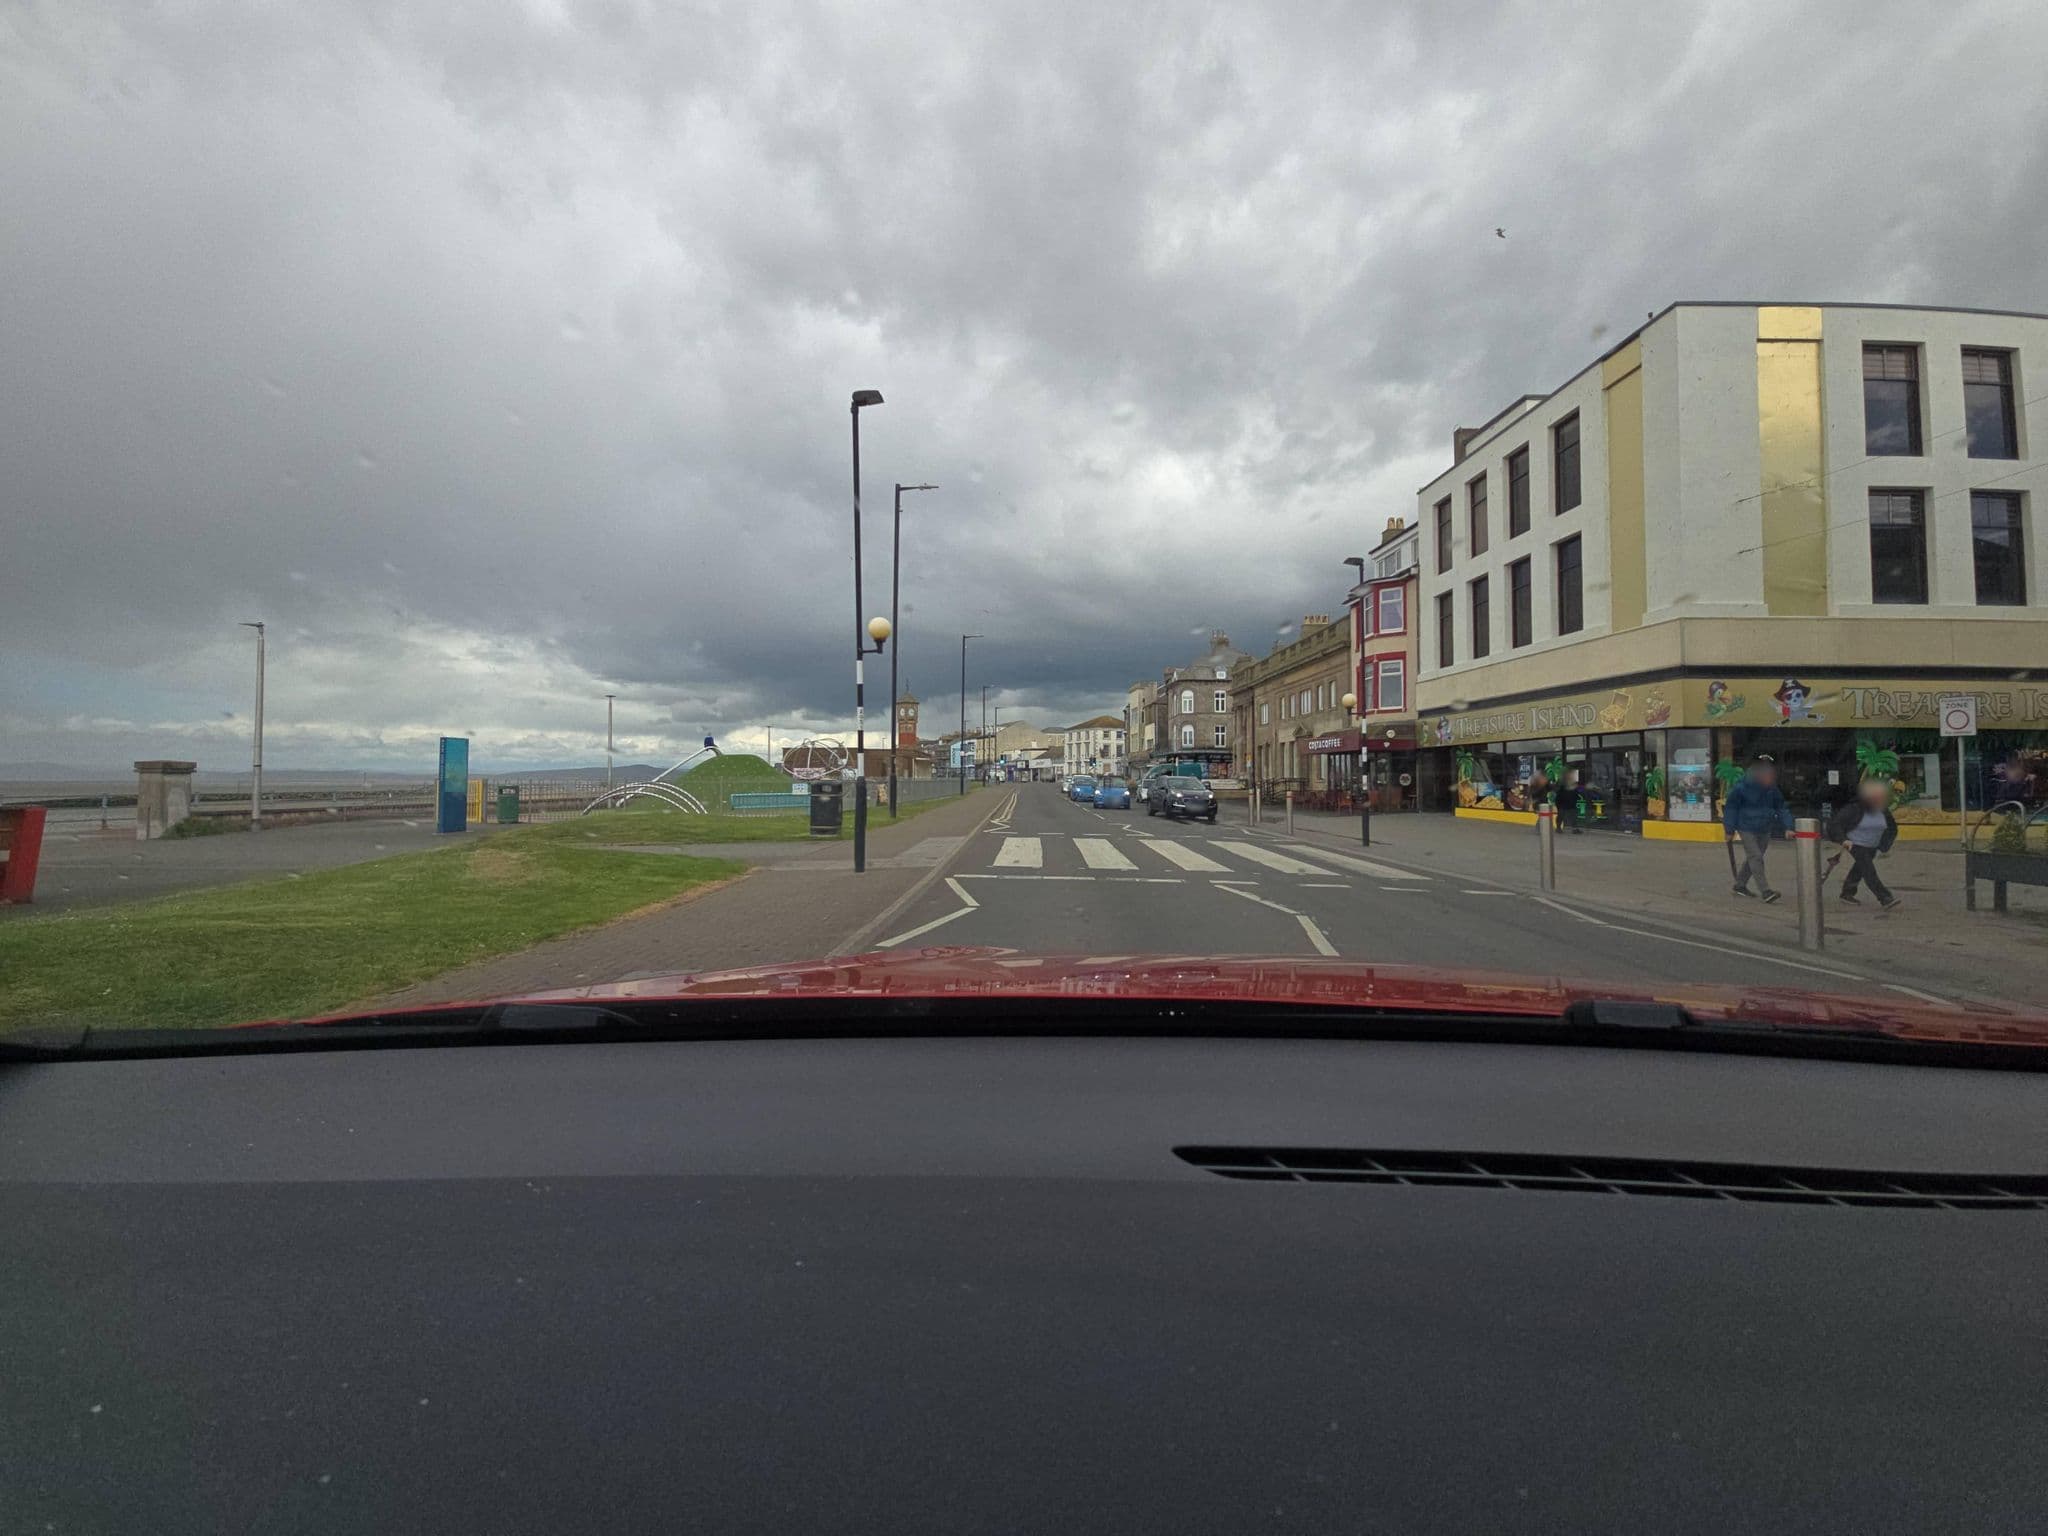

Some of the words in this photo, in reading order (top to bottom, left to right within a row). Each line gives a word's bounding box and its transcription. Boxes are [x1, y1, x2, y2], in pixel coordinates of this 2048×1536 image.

[1455, 712, 1525, 739] TREASURE
[1529, 702, 1598, 733] ISLAND
[1841, 687, 2013, 722] TREARE
